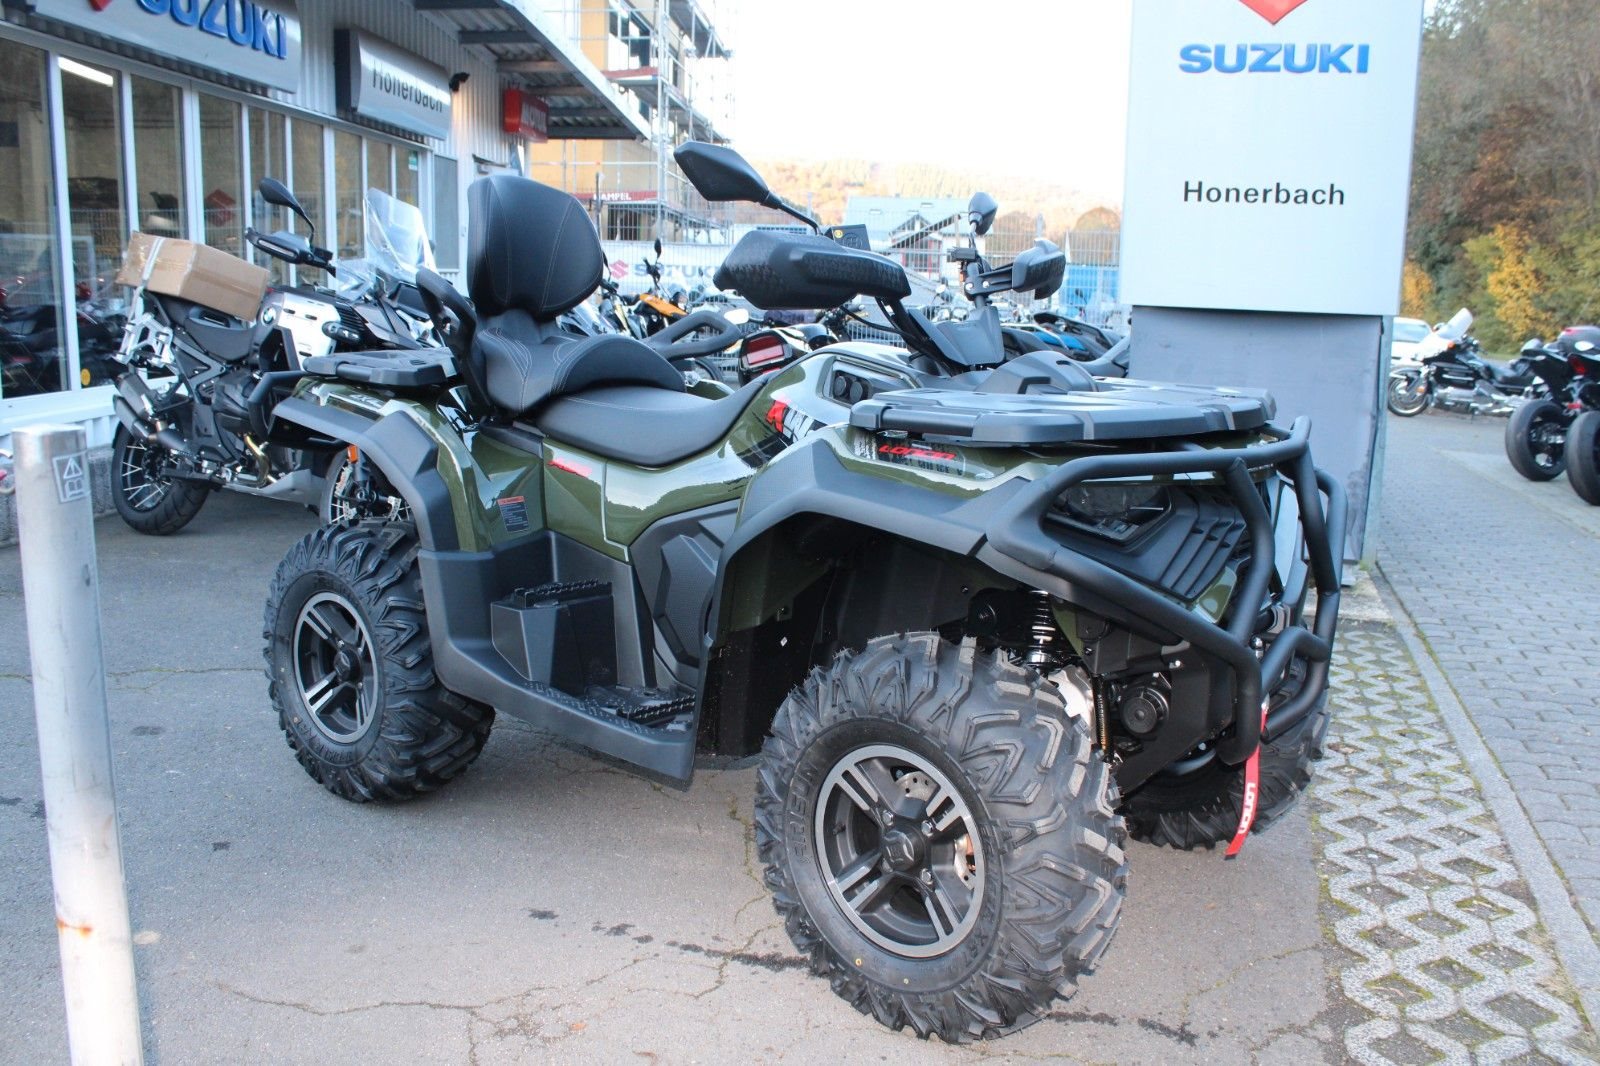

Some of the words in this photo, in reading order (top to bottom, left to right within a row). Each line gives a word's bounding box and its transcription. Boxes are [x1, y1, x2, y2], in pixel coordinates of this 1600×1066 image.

[136, 0, 287, 59] UZUKI
[1178, 43, 1370, 74] SUZUKI
[372, 61, 443, 113] Honerbach
[1183, 180, 1345, 206] Honerbach
